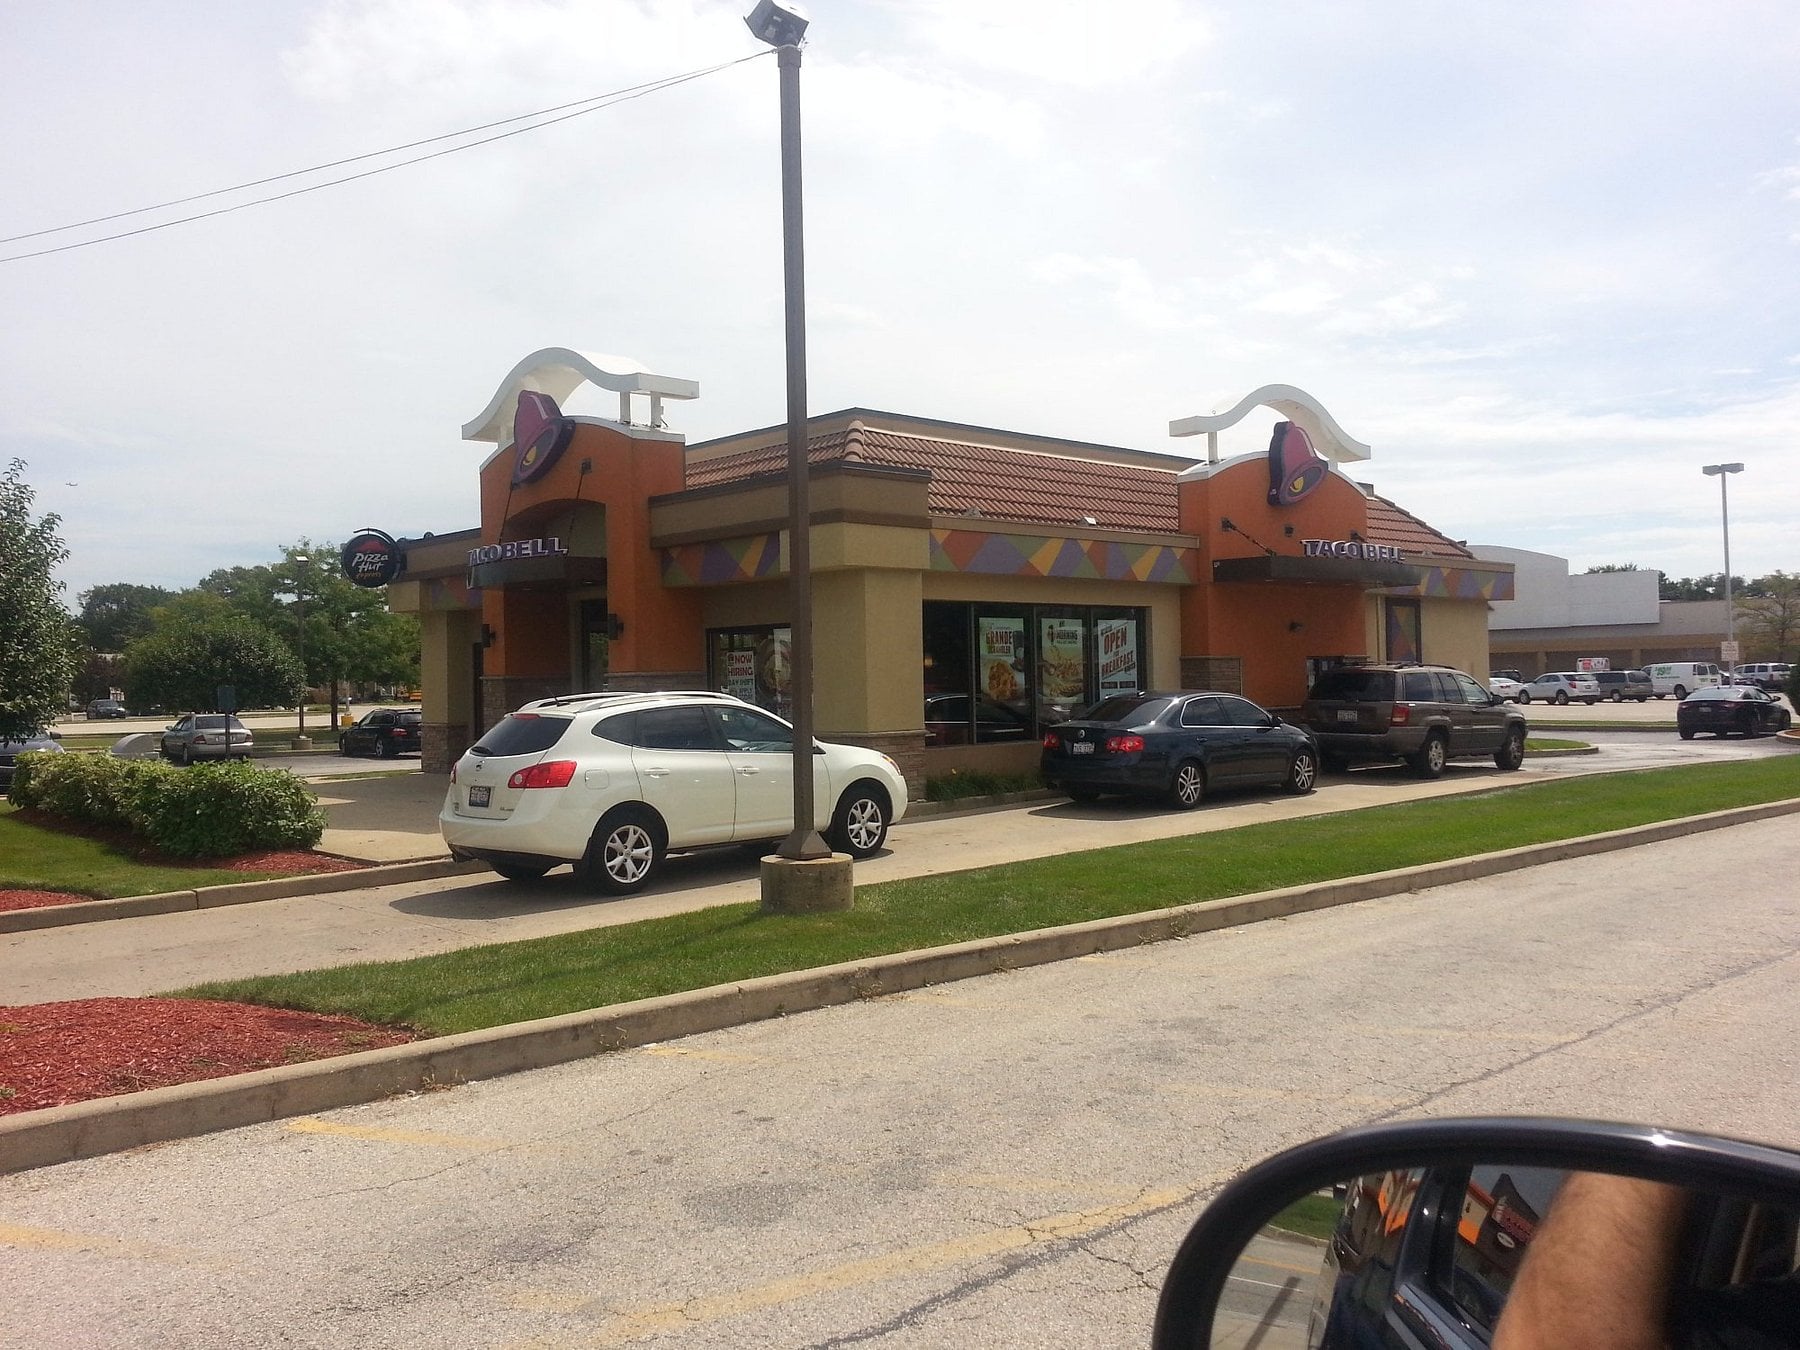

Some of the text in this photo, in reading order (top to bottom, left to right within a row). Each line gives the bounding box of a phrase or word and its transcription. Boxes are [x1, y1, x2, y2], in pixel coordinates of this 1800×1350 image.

[501, 537, 568, 560] BELL
[1301, 539, 1406, 563] TACO BELL
[352, 552, 389, 567] Pizza
[358, 561, 384, 573] Hut
[986, 630, 1012, 645] GRANDE
[1104, 625, 1128, 655] OPEN
[735, 654, 752, 664] NOW
[1102, 650, 1133, 678] BREAKFAST
[728, 667, 753, 676] HIRING
